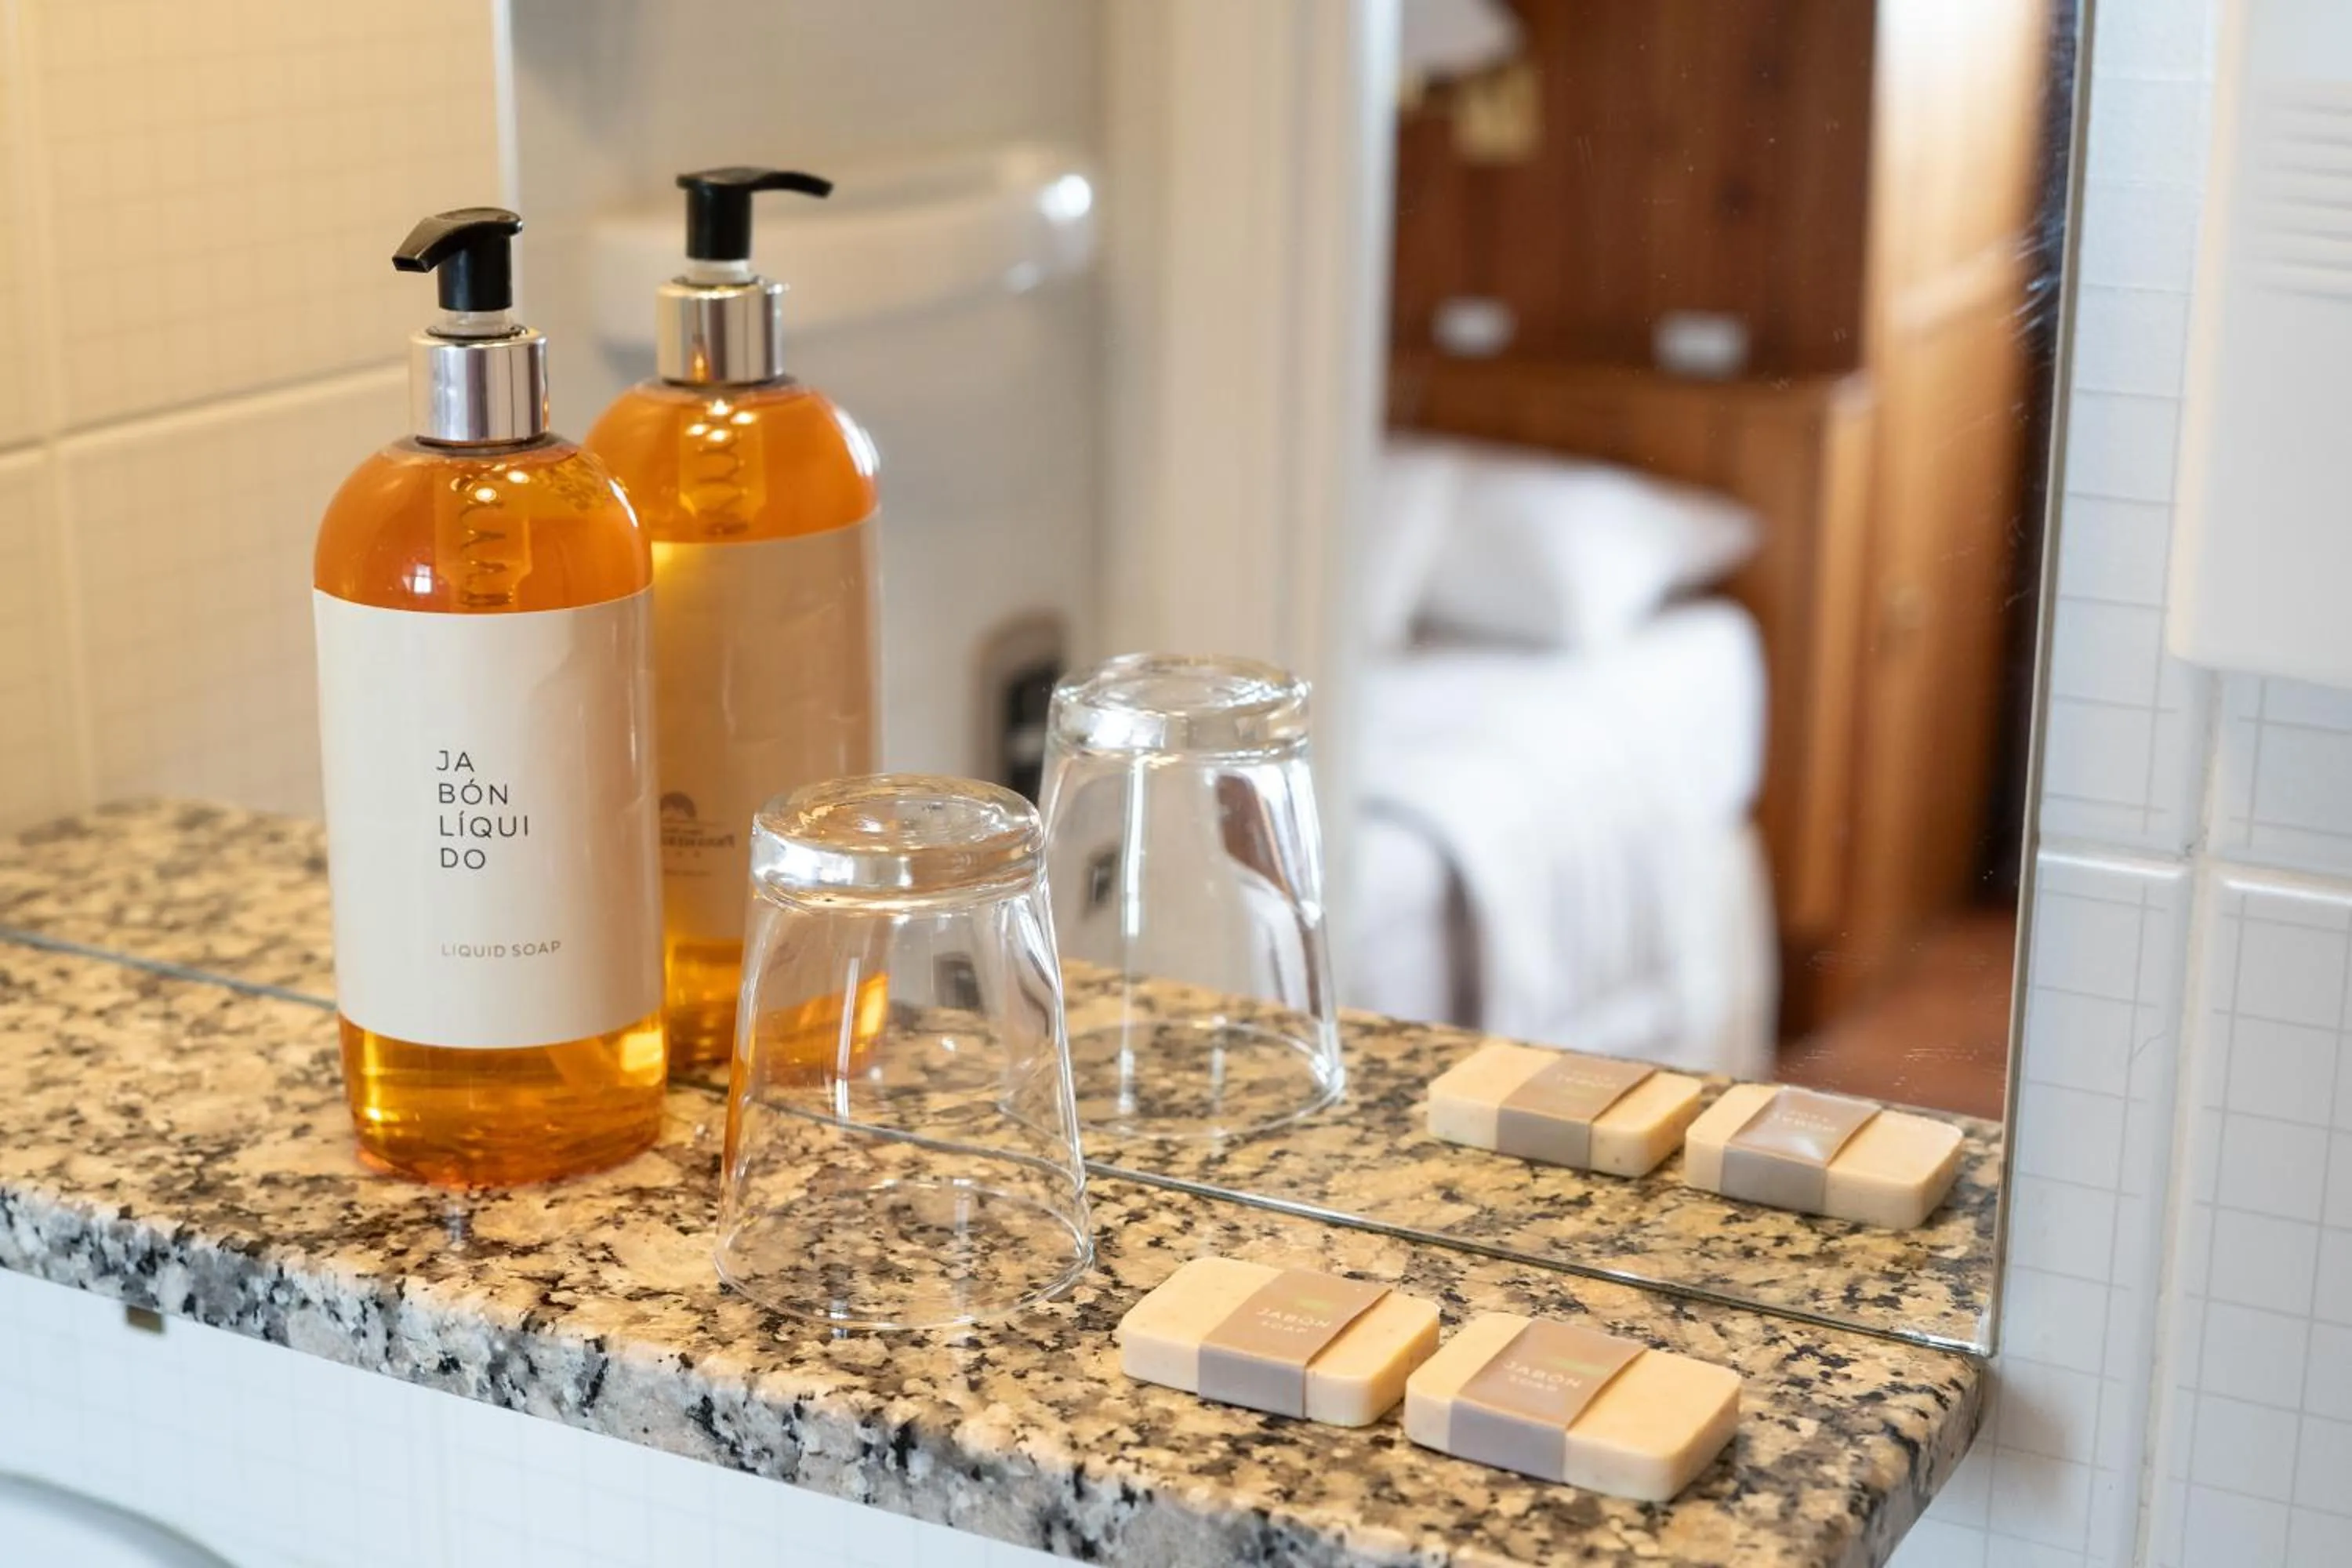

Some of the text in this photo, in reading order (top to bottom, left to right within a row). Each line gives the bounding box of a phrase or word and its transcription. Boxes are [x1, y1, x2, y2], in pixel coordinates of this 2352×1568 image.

[436, 750, 474, 772] JA
[438, 779, 508, 804] BÓN
[439, 811, 528, 838] LÍQUI
[440, 847, 486, 869] DO
[441, 941, 561, 957] LIQUID SOAP
